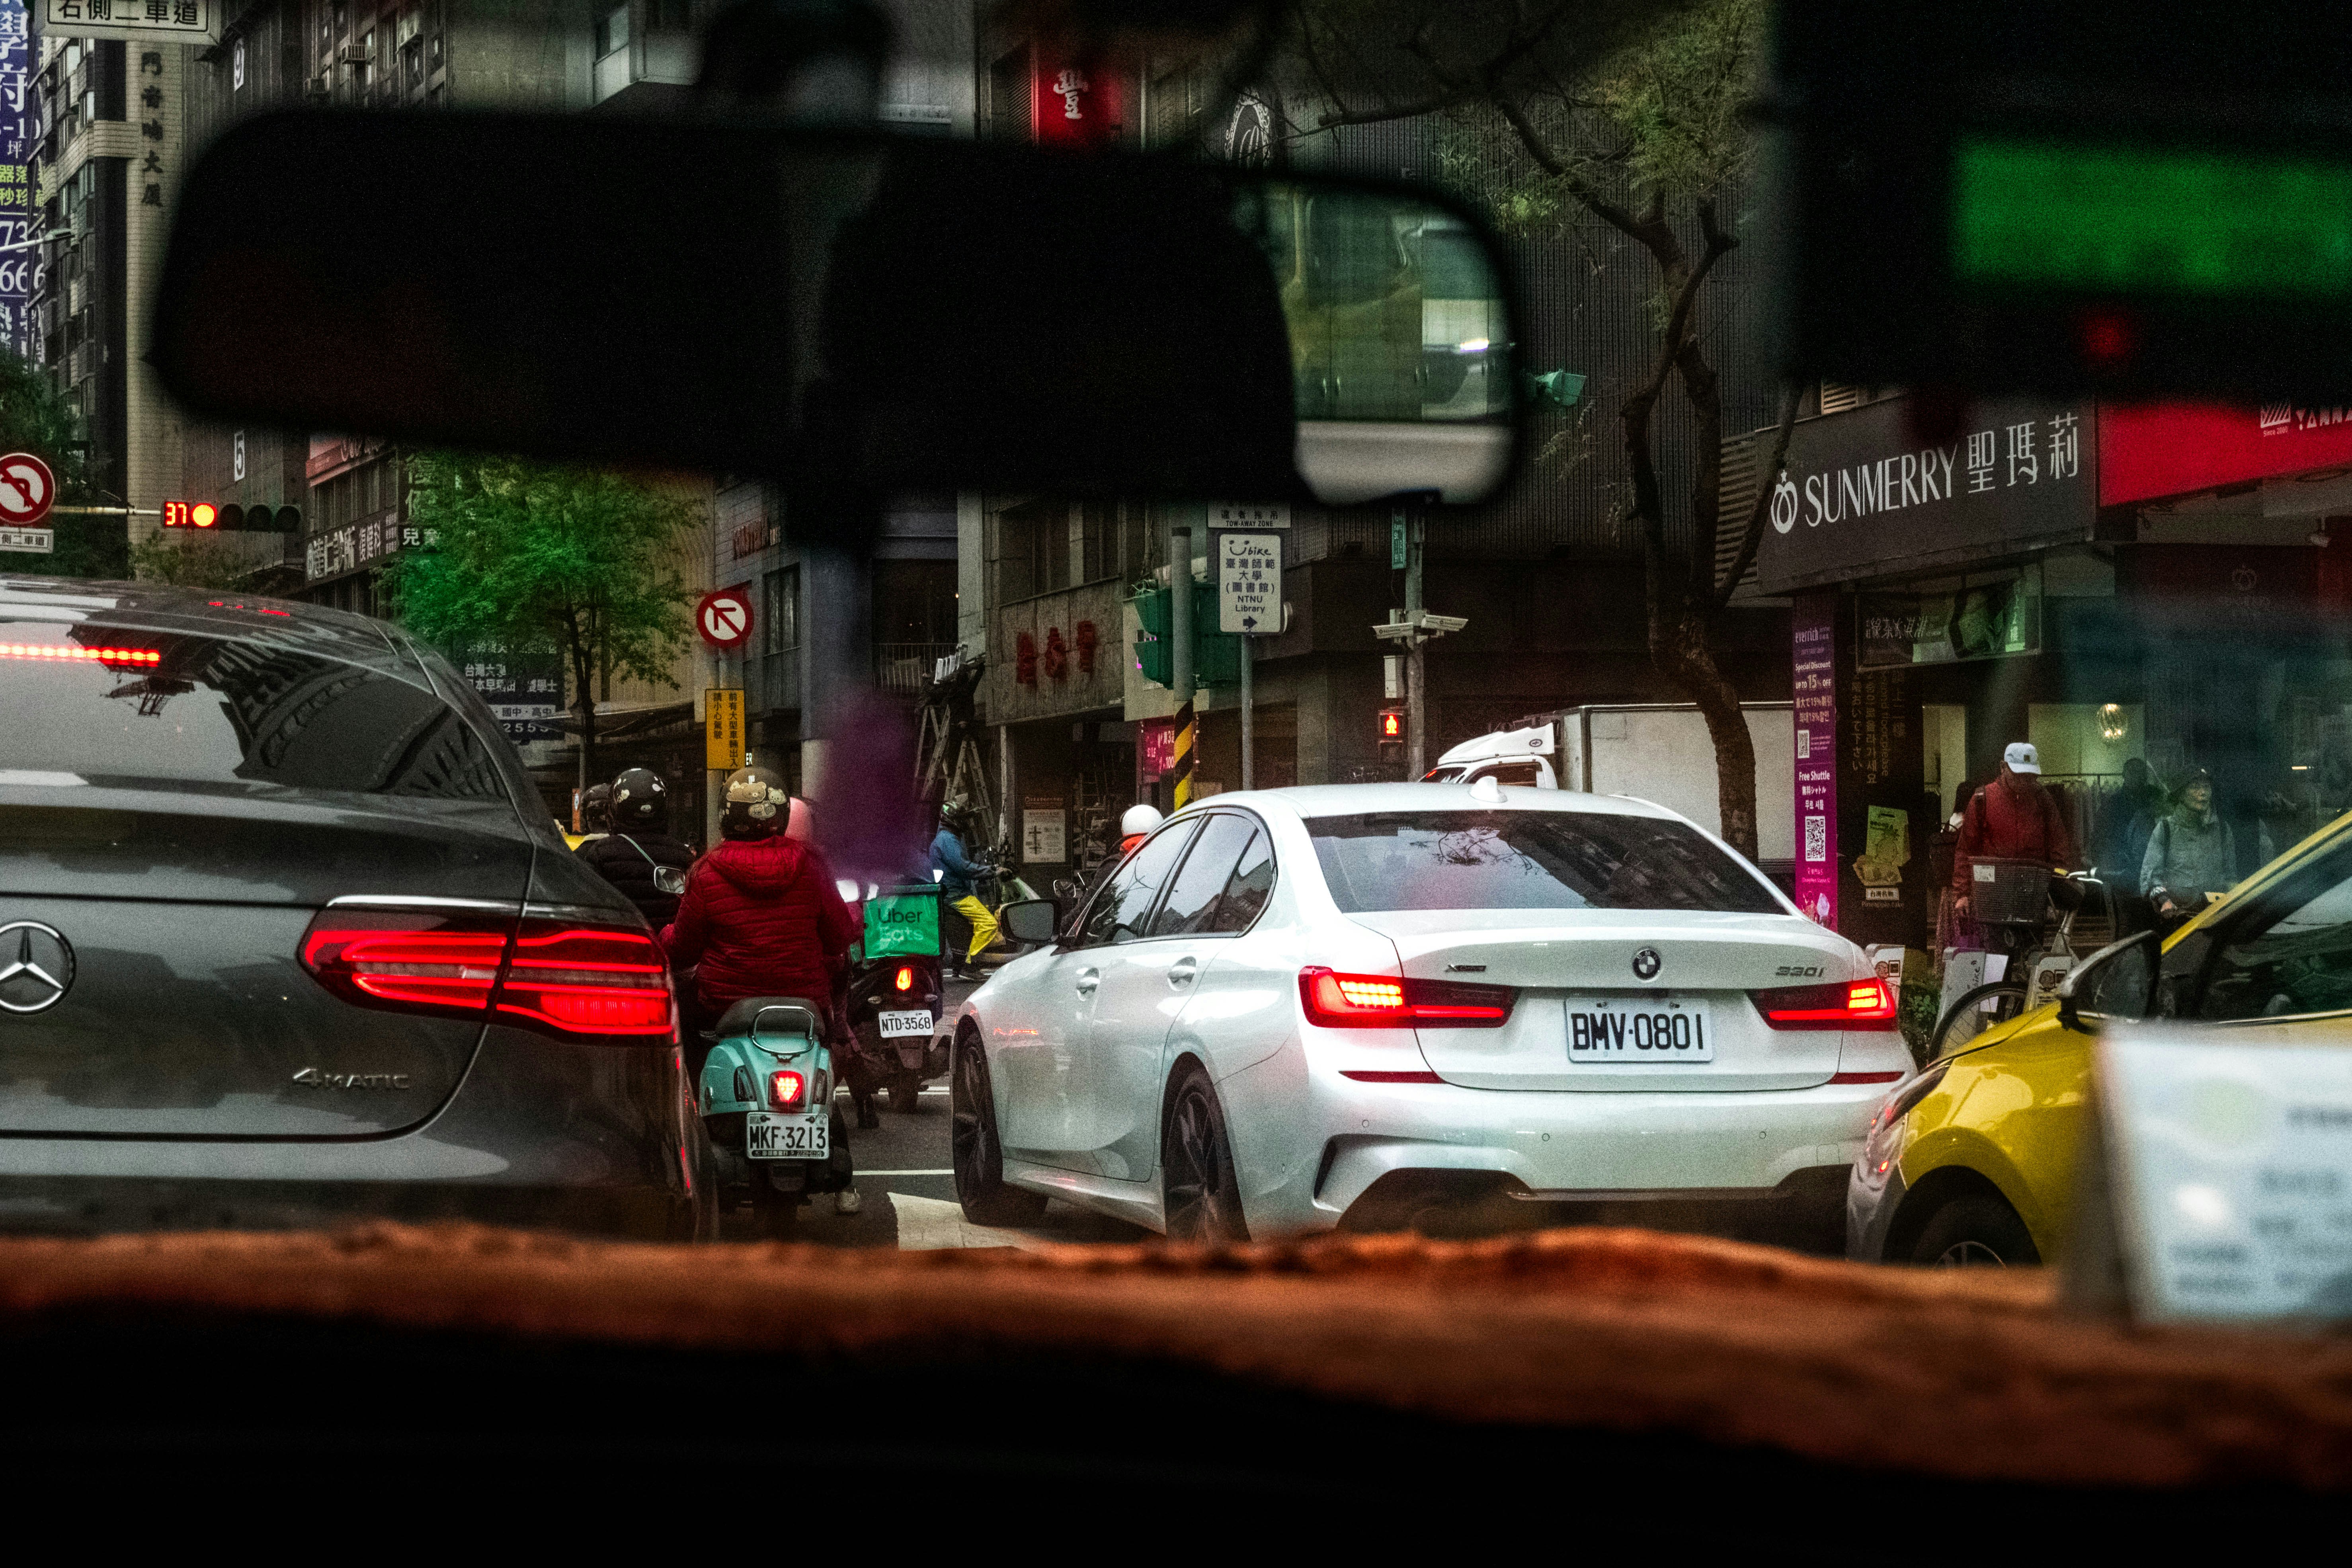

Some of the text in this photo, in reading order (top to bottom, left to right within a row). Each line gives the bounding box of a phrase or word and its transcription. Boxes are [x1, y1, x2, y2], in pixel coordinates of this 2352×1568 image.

[7, 141, 23, 160] 坪
[236, 438, 244, 477] 5
[1805, 412, 2079, 528] SUNMERRY 聖瑪莉
[166, 502, 187, 526] 37
[1226, 558, 1275, 569] 臺灣師範
[1239, 570, 1262, 581] 大學
[1226, 582, 1275, 594] (圖書館)
[1235, 605, 1265, 614] Library
[1795, 660, 1831, 672] Special Discount
[1822, 679, 1831, 687] OFF
[1799, 770, 1831, 781] Free Shuttle
[878, 908, 923, 924] Uber
[879, 926, 924, 943] Eats
